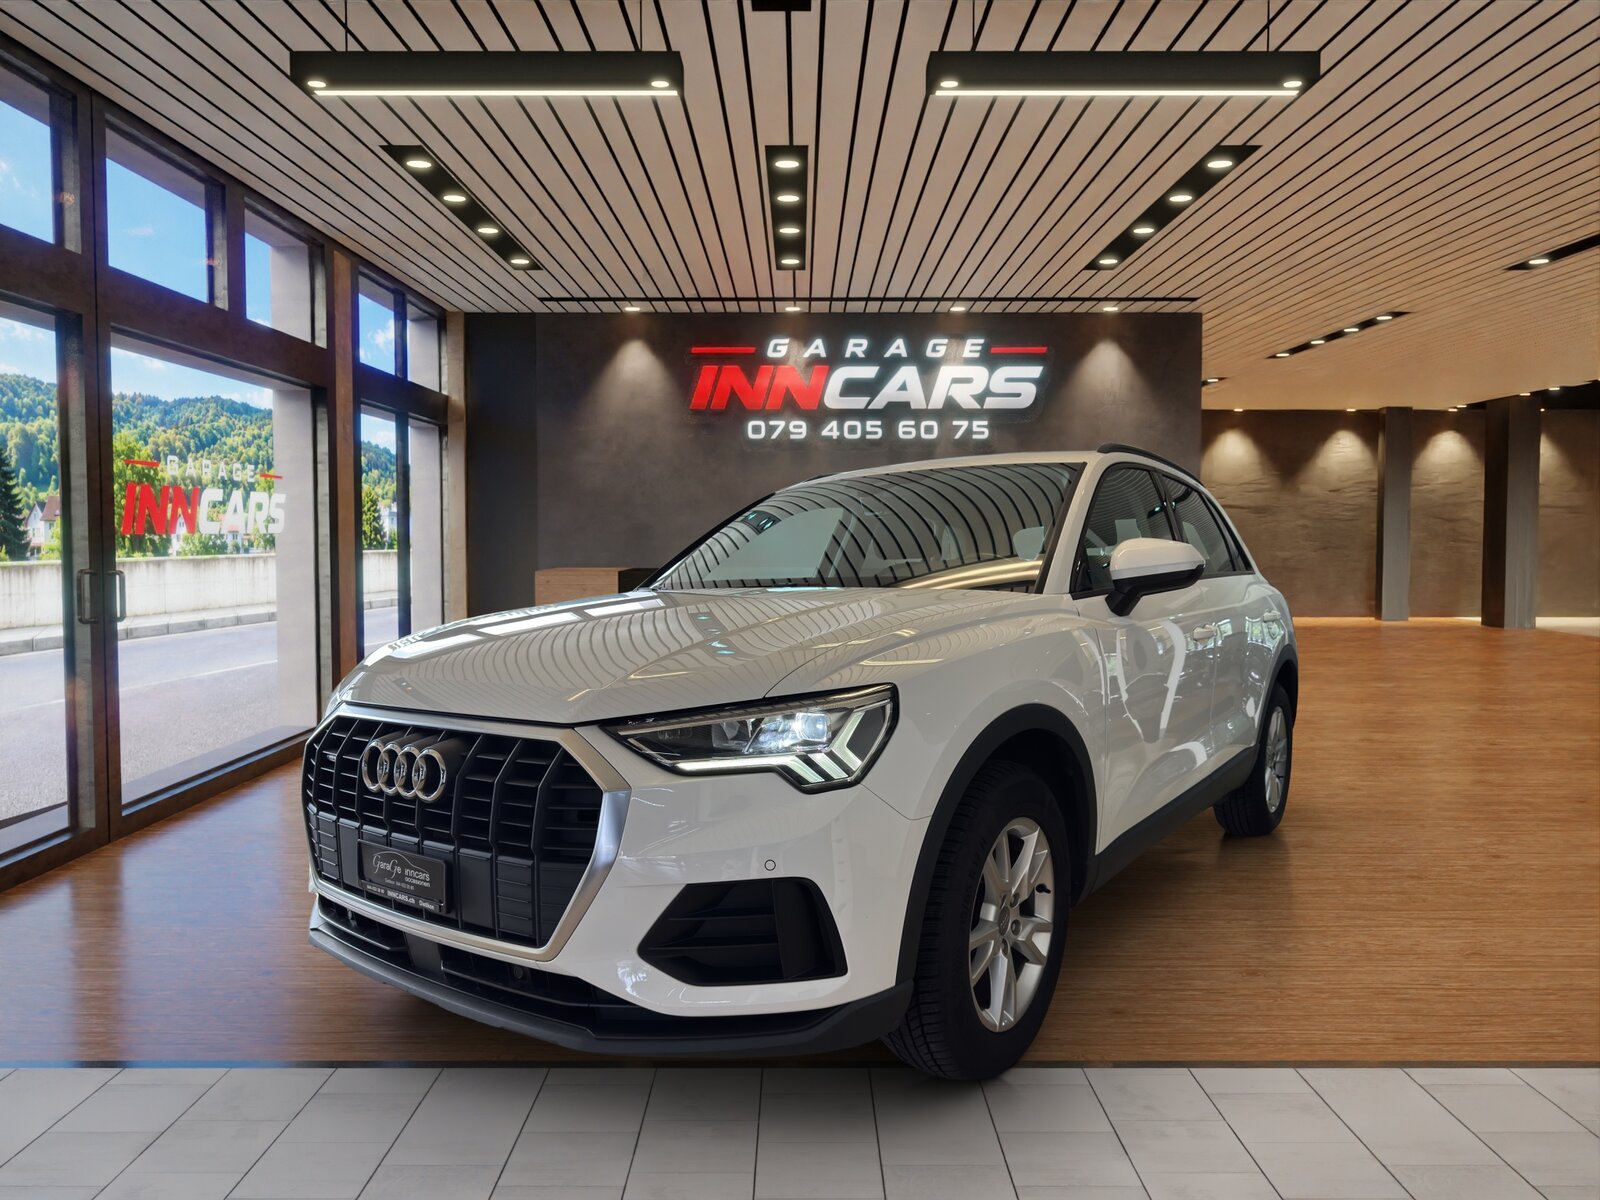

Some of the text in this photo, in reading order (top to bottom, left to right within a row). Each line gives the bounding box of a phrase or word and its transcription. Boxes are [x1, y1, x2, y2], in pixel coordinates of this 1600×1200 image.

[766, 338, 986, 358] GARAGE
[689, 365, 1044, 410] INNCARS
[747, 420, 990, 440] 079 405 60 75
[167, 455, 256, 482] GARAGE
[121, 481, 287, 535] INNCARS
[404, 868, 430, 881] inncars
